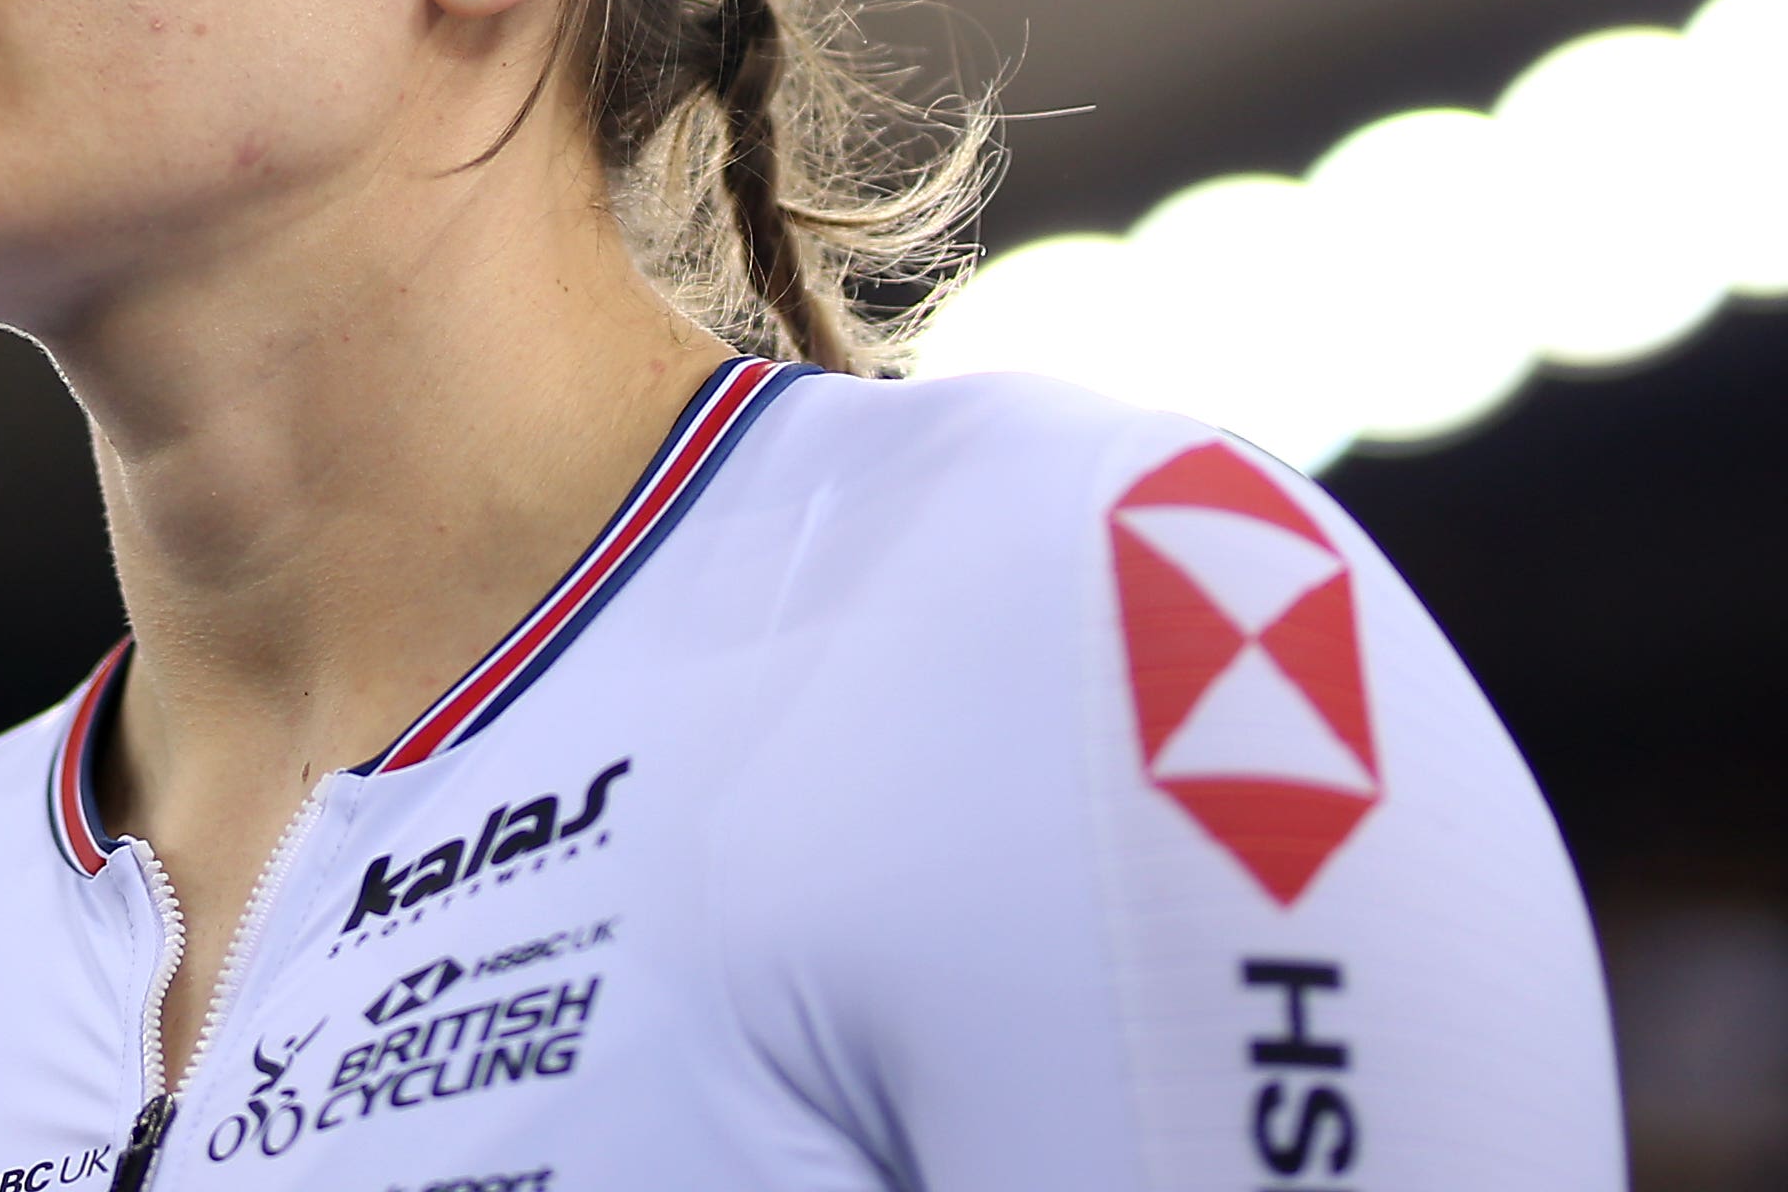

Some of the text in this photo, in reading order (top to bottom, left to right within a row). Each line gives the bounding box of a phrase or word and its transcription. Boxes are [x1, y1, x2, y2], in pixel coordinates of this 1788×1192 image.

[341, 759, 630, 935] kalas
[317, 1031, 583, 1130] CYCLING
[329, 976, 601, 1091] BRITISH
[1241, 959, 1357, 1192] HS
[59, 1144, 111, 1184] UK
